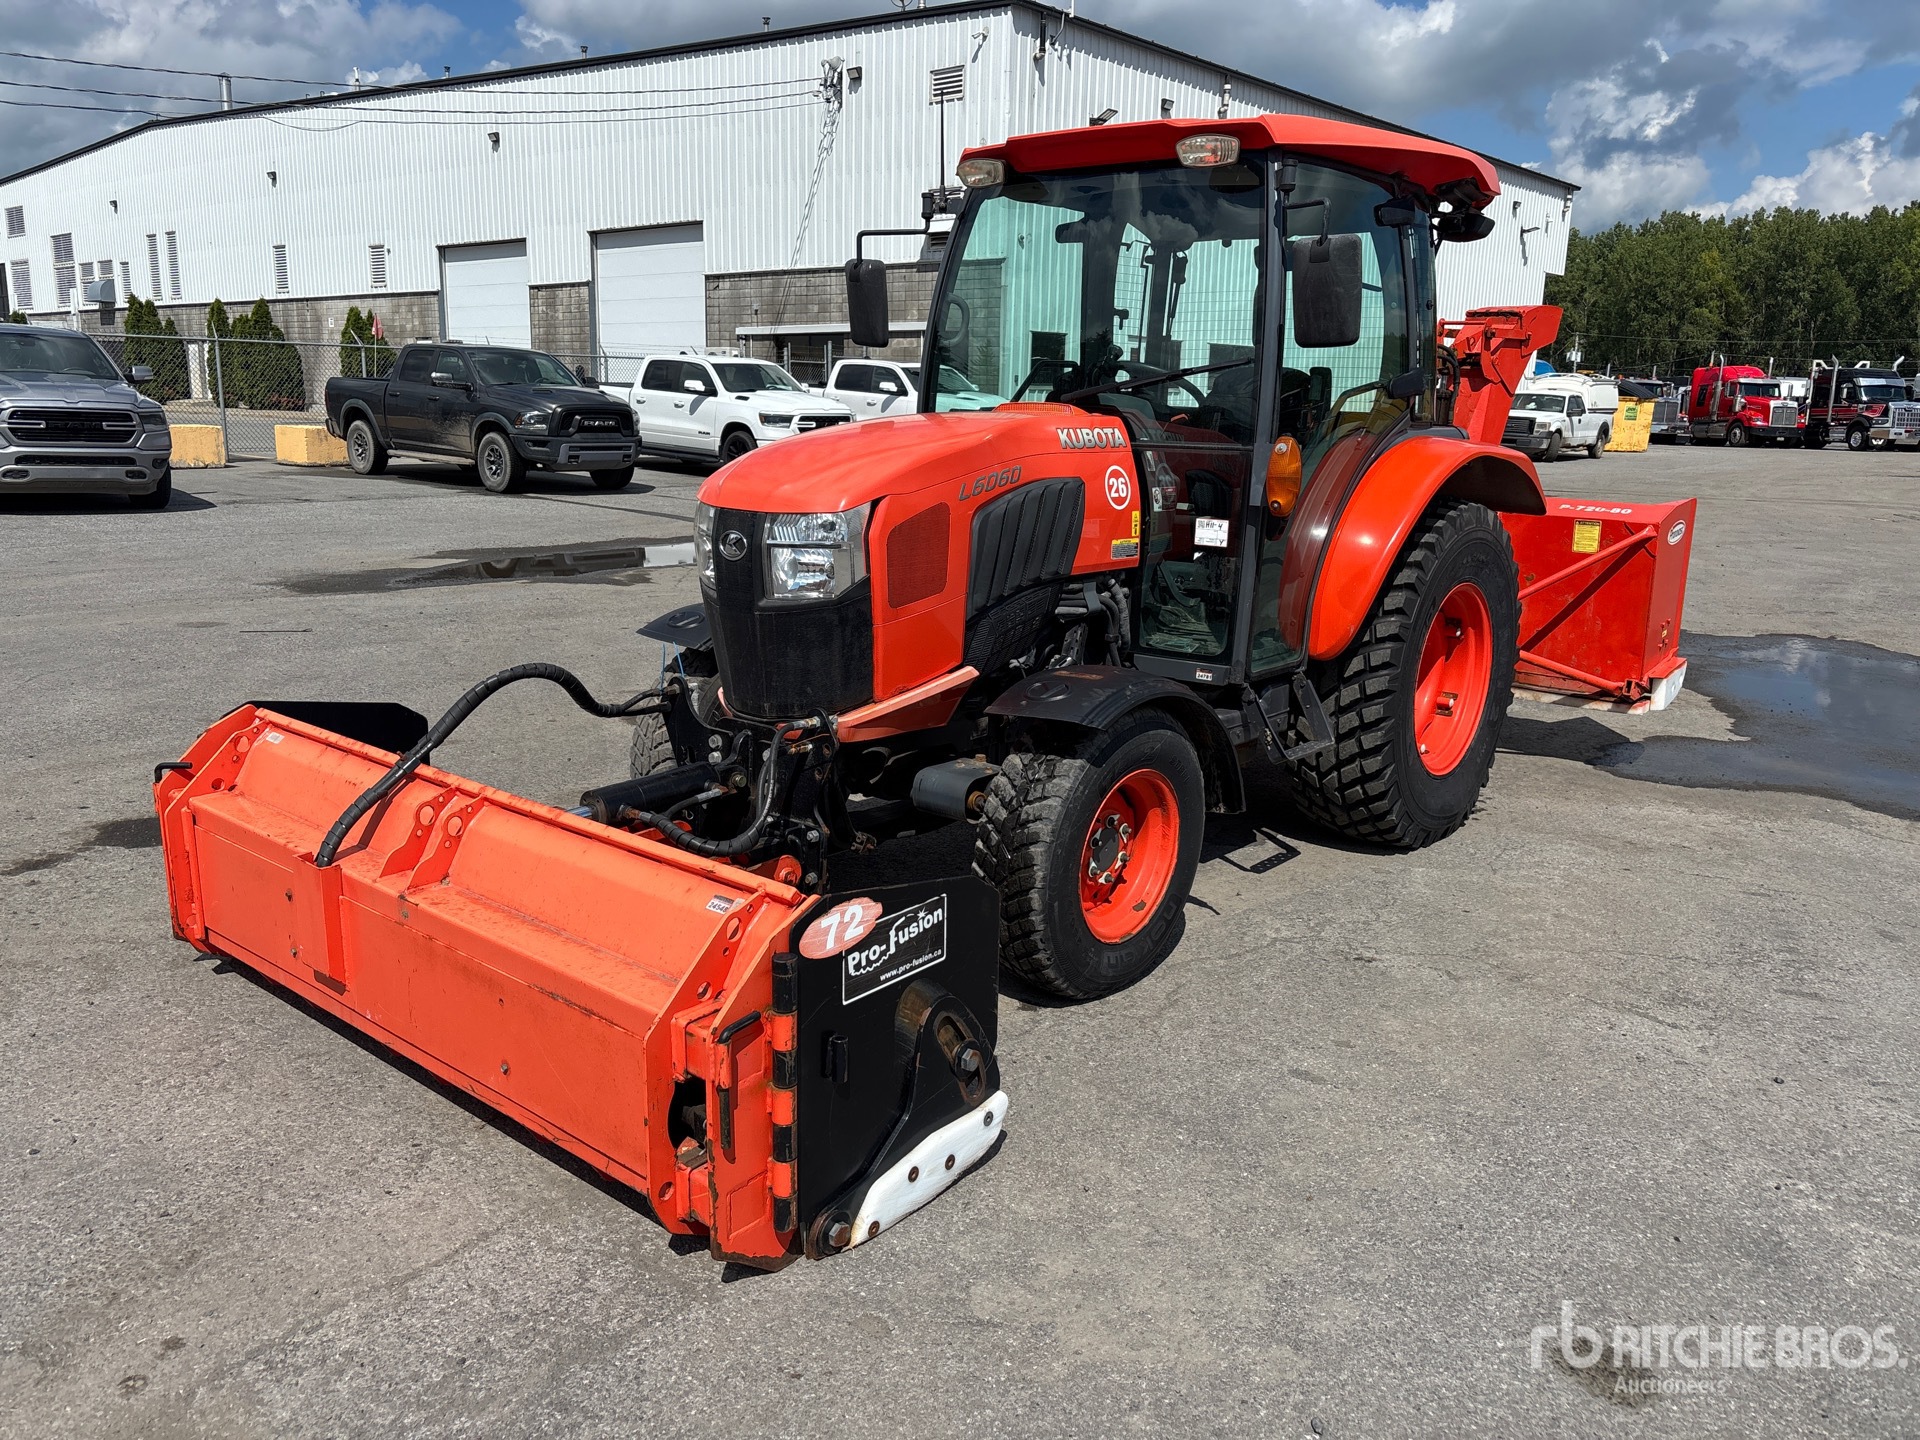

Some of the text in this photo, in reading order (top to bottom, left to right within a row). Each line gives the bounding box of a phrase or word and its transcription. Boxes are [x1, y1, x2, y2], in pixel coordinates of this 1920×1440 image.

[1057, 427, 1127, 449] KUBOTA
[959, 466, 1023, 501] L6060
[1109, 477, 1127, 498] 26
[1559, 504, 1632, 515] P-720-80
[820, 904, 864, 950] 72
[880, 949, 942, 982] www.pro-fusion.ca
